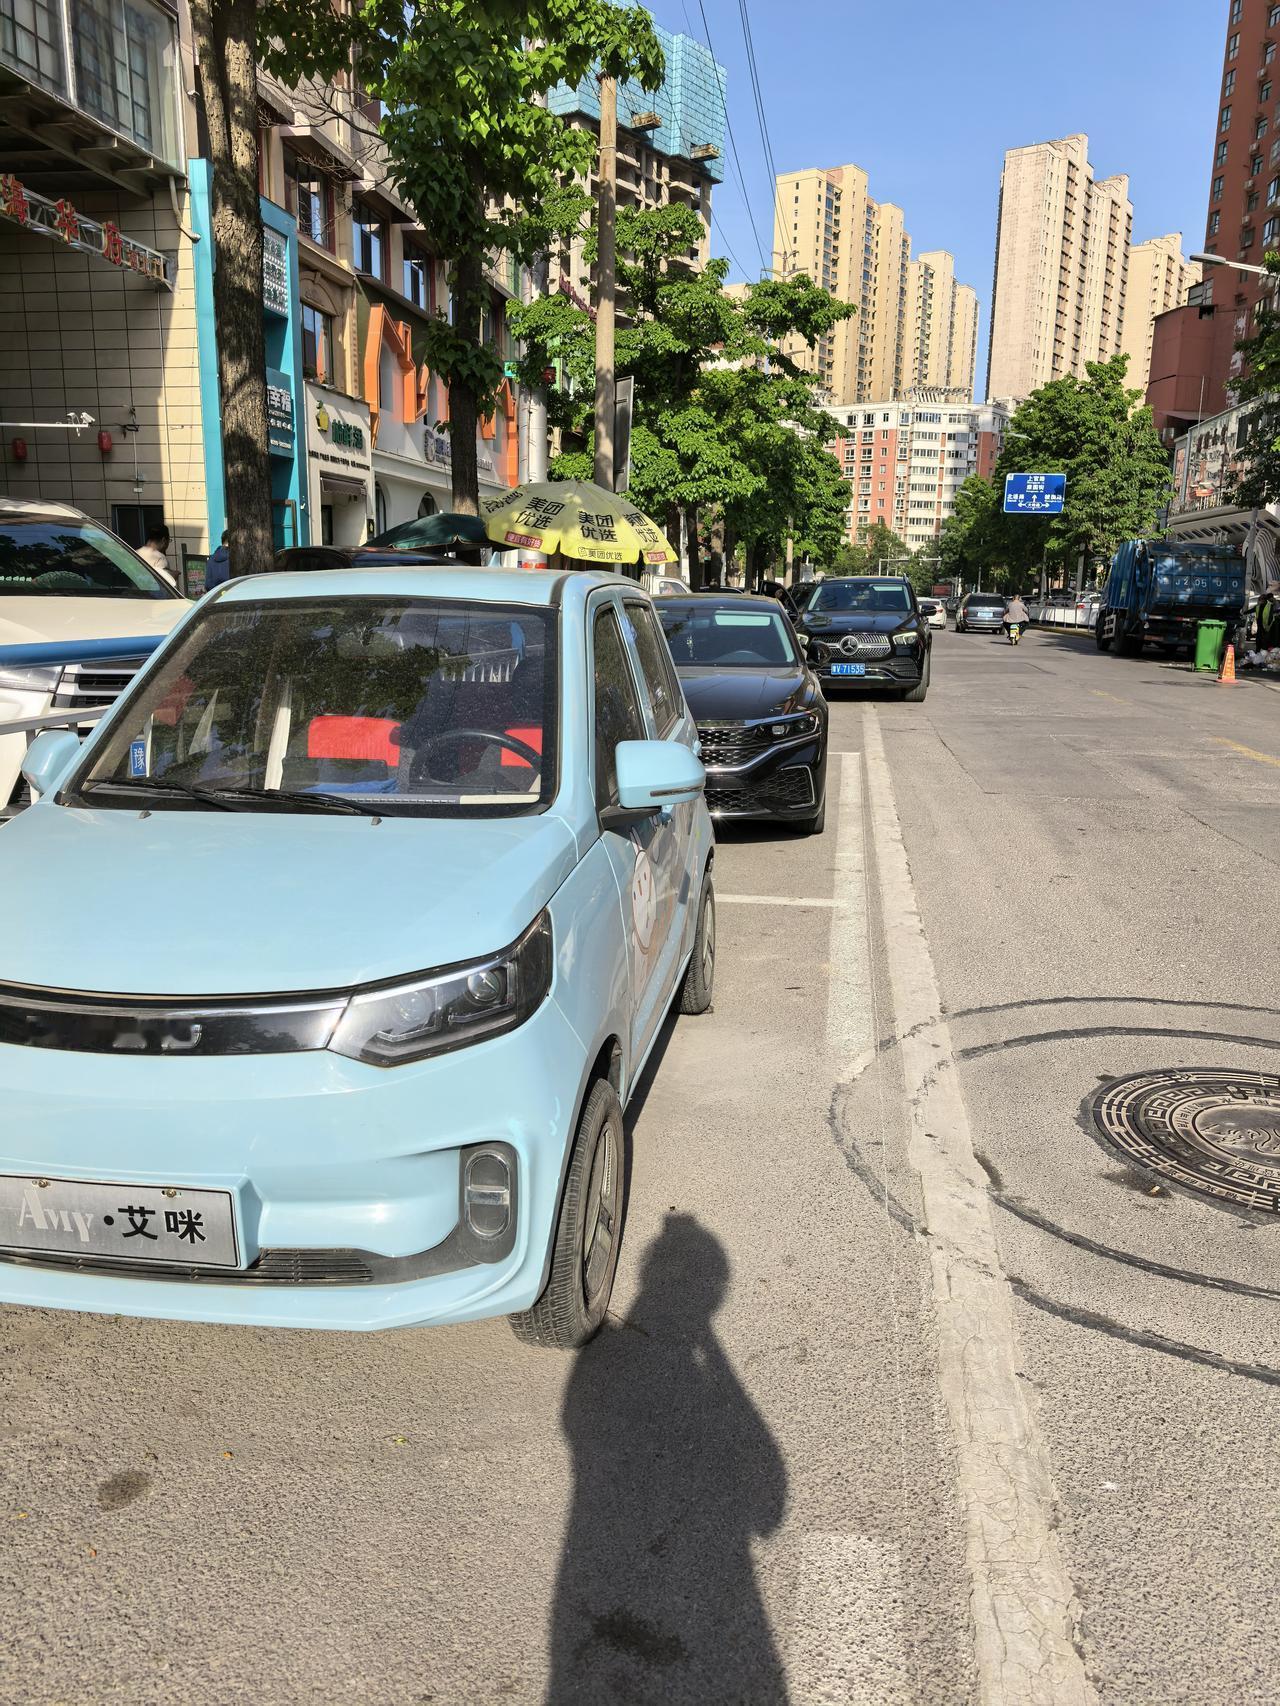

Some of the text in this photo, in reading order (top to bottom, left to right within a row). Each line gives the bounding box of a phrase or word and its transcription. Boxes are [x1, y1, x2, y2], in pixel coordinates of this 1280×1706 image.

[525, 496, 565, 516] 美团
[515, 510, 554, 530] 优选
[578, 510, 615, 528] 美团
[580, 525, 619, 543] 优选
[588, 550, 623, 561] 美团优选
[133, 747, 145, 770] 豫
